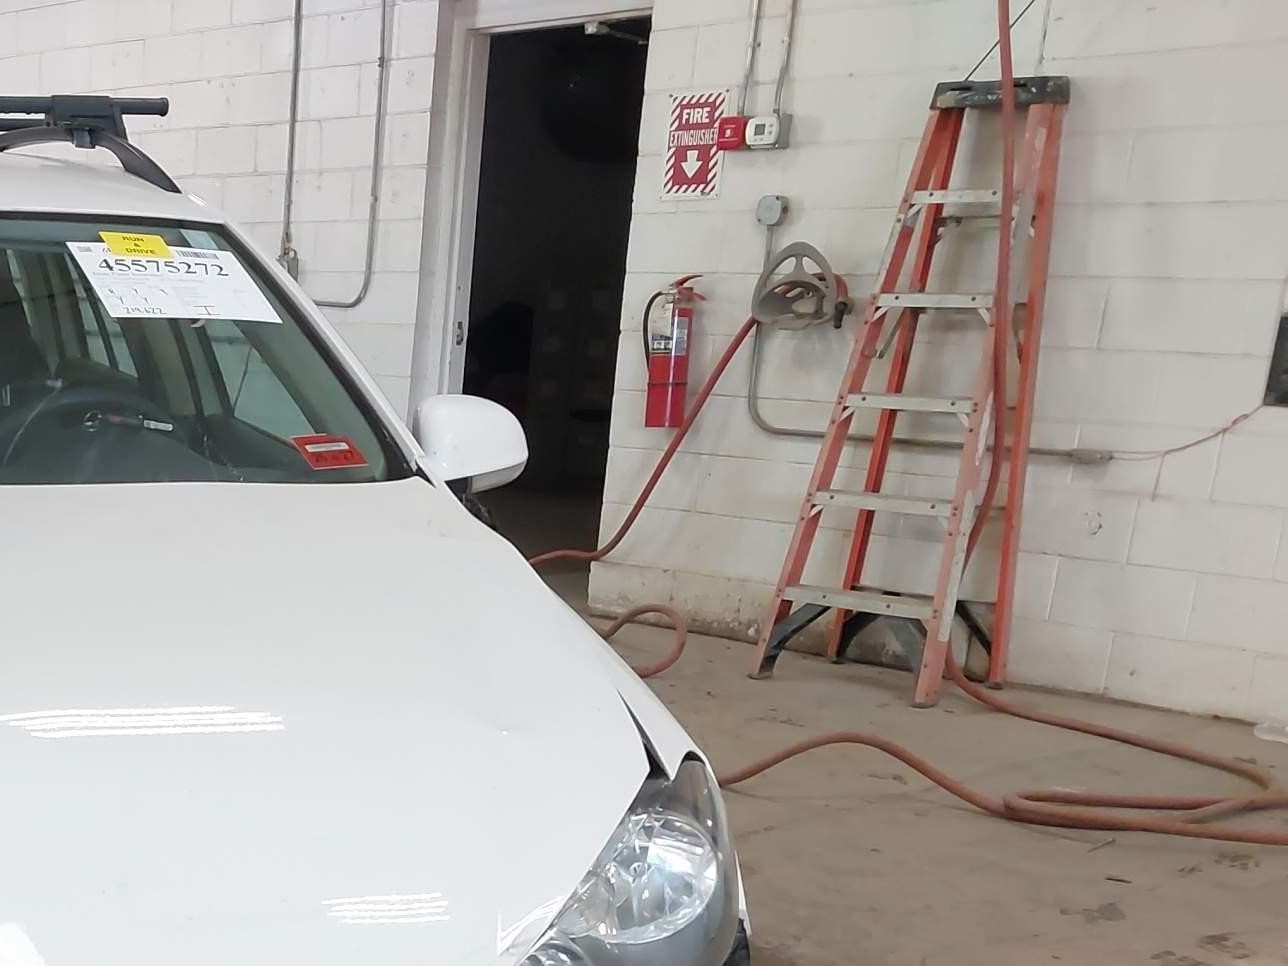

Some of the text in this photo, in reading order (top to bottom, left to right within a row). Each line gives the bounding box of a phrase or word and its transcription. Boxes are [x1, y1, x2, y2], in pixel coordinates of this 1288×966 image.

[682, 106, 711, 124] FIRE
[669, 126, 719, 147] EXTINGUISHER
[125, 247, 156, 255] DRIVE
[98, 257, 229, 277] 45575272
